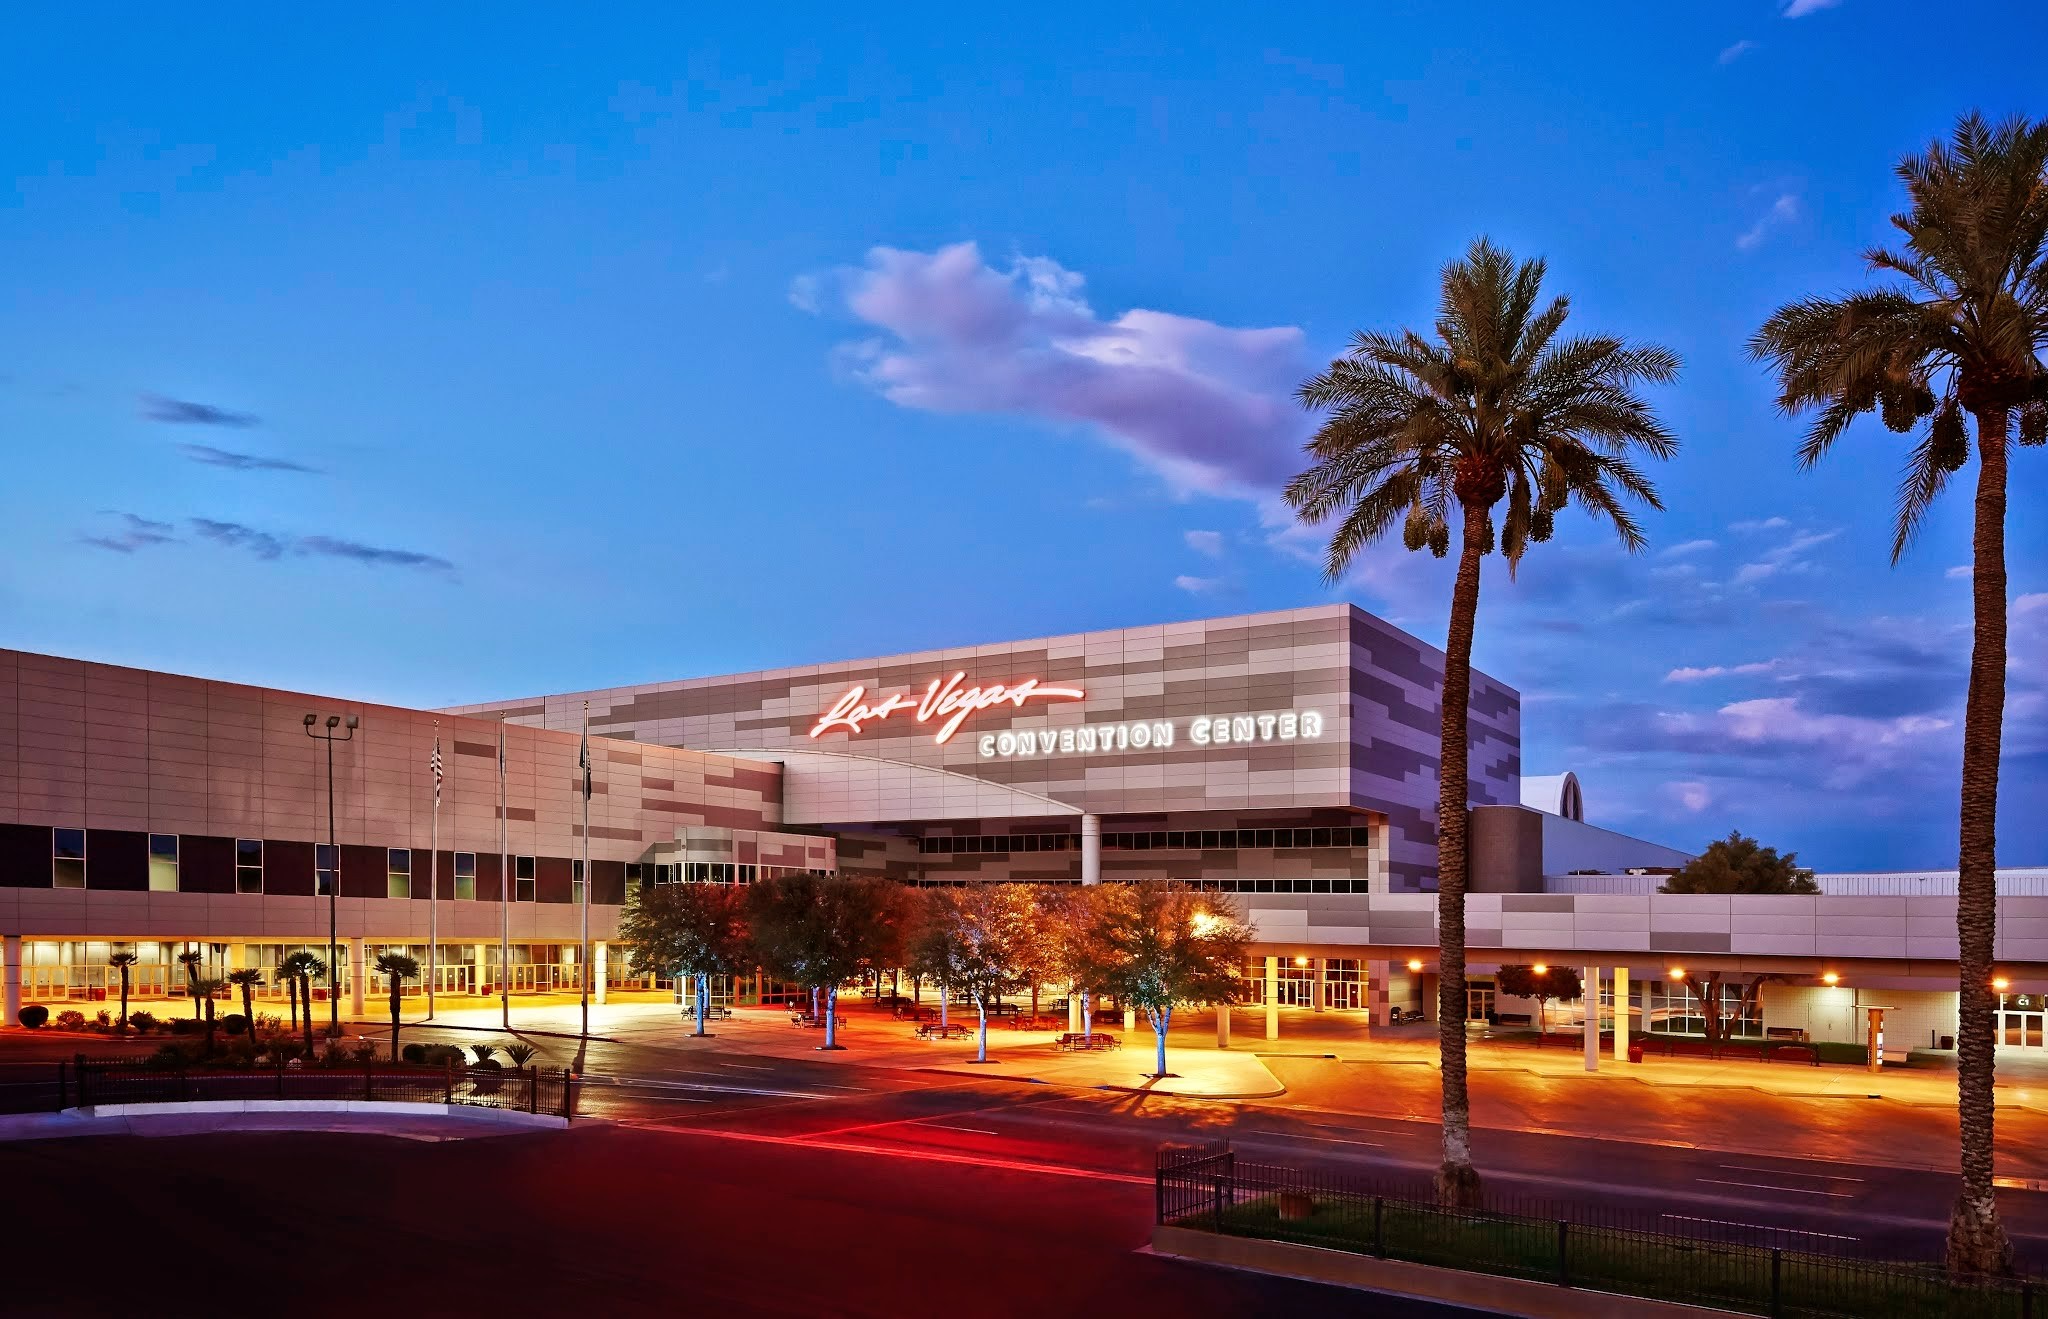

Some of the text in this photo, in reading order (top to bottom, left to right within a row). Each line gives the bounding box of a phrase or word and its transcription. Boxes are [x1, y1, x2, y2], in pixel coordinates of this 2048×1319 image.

[810, 671, 1085, 744] Las Vegas
[979, 711, 1323, 757] CONVENTION CENTER
[2018, 998, 2030, 1006] C1
